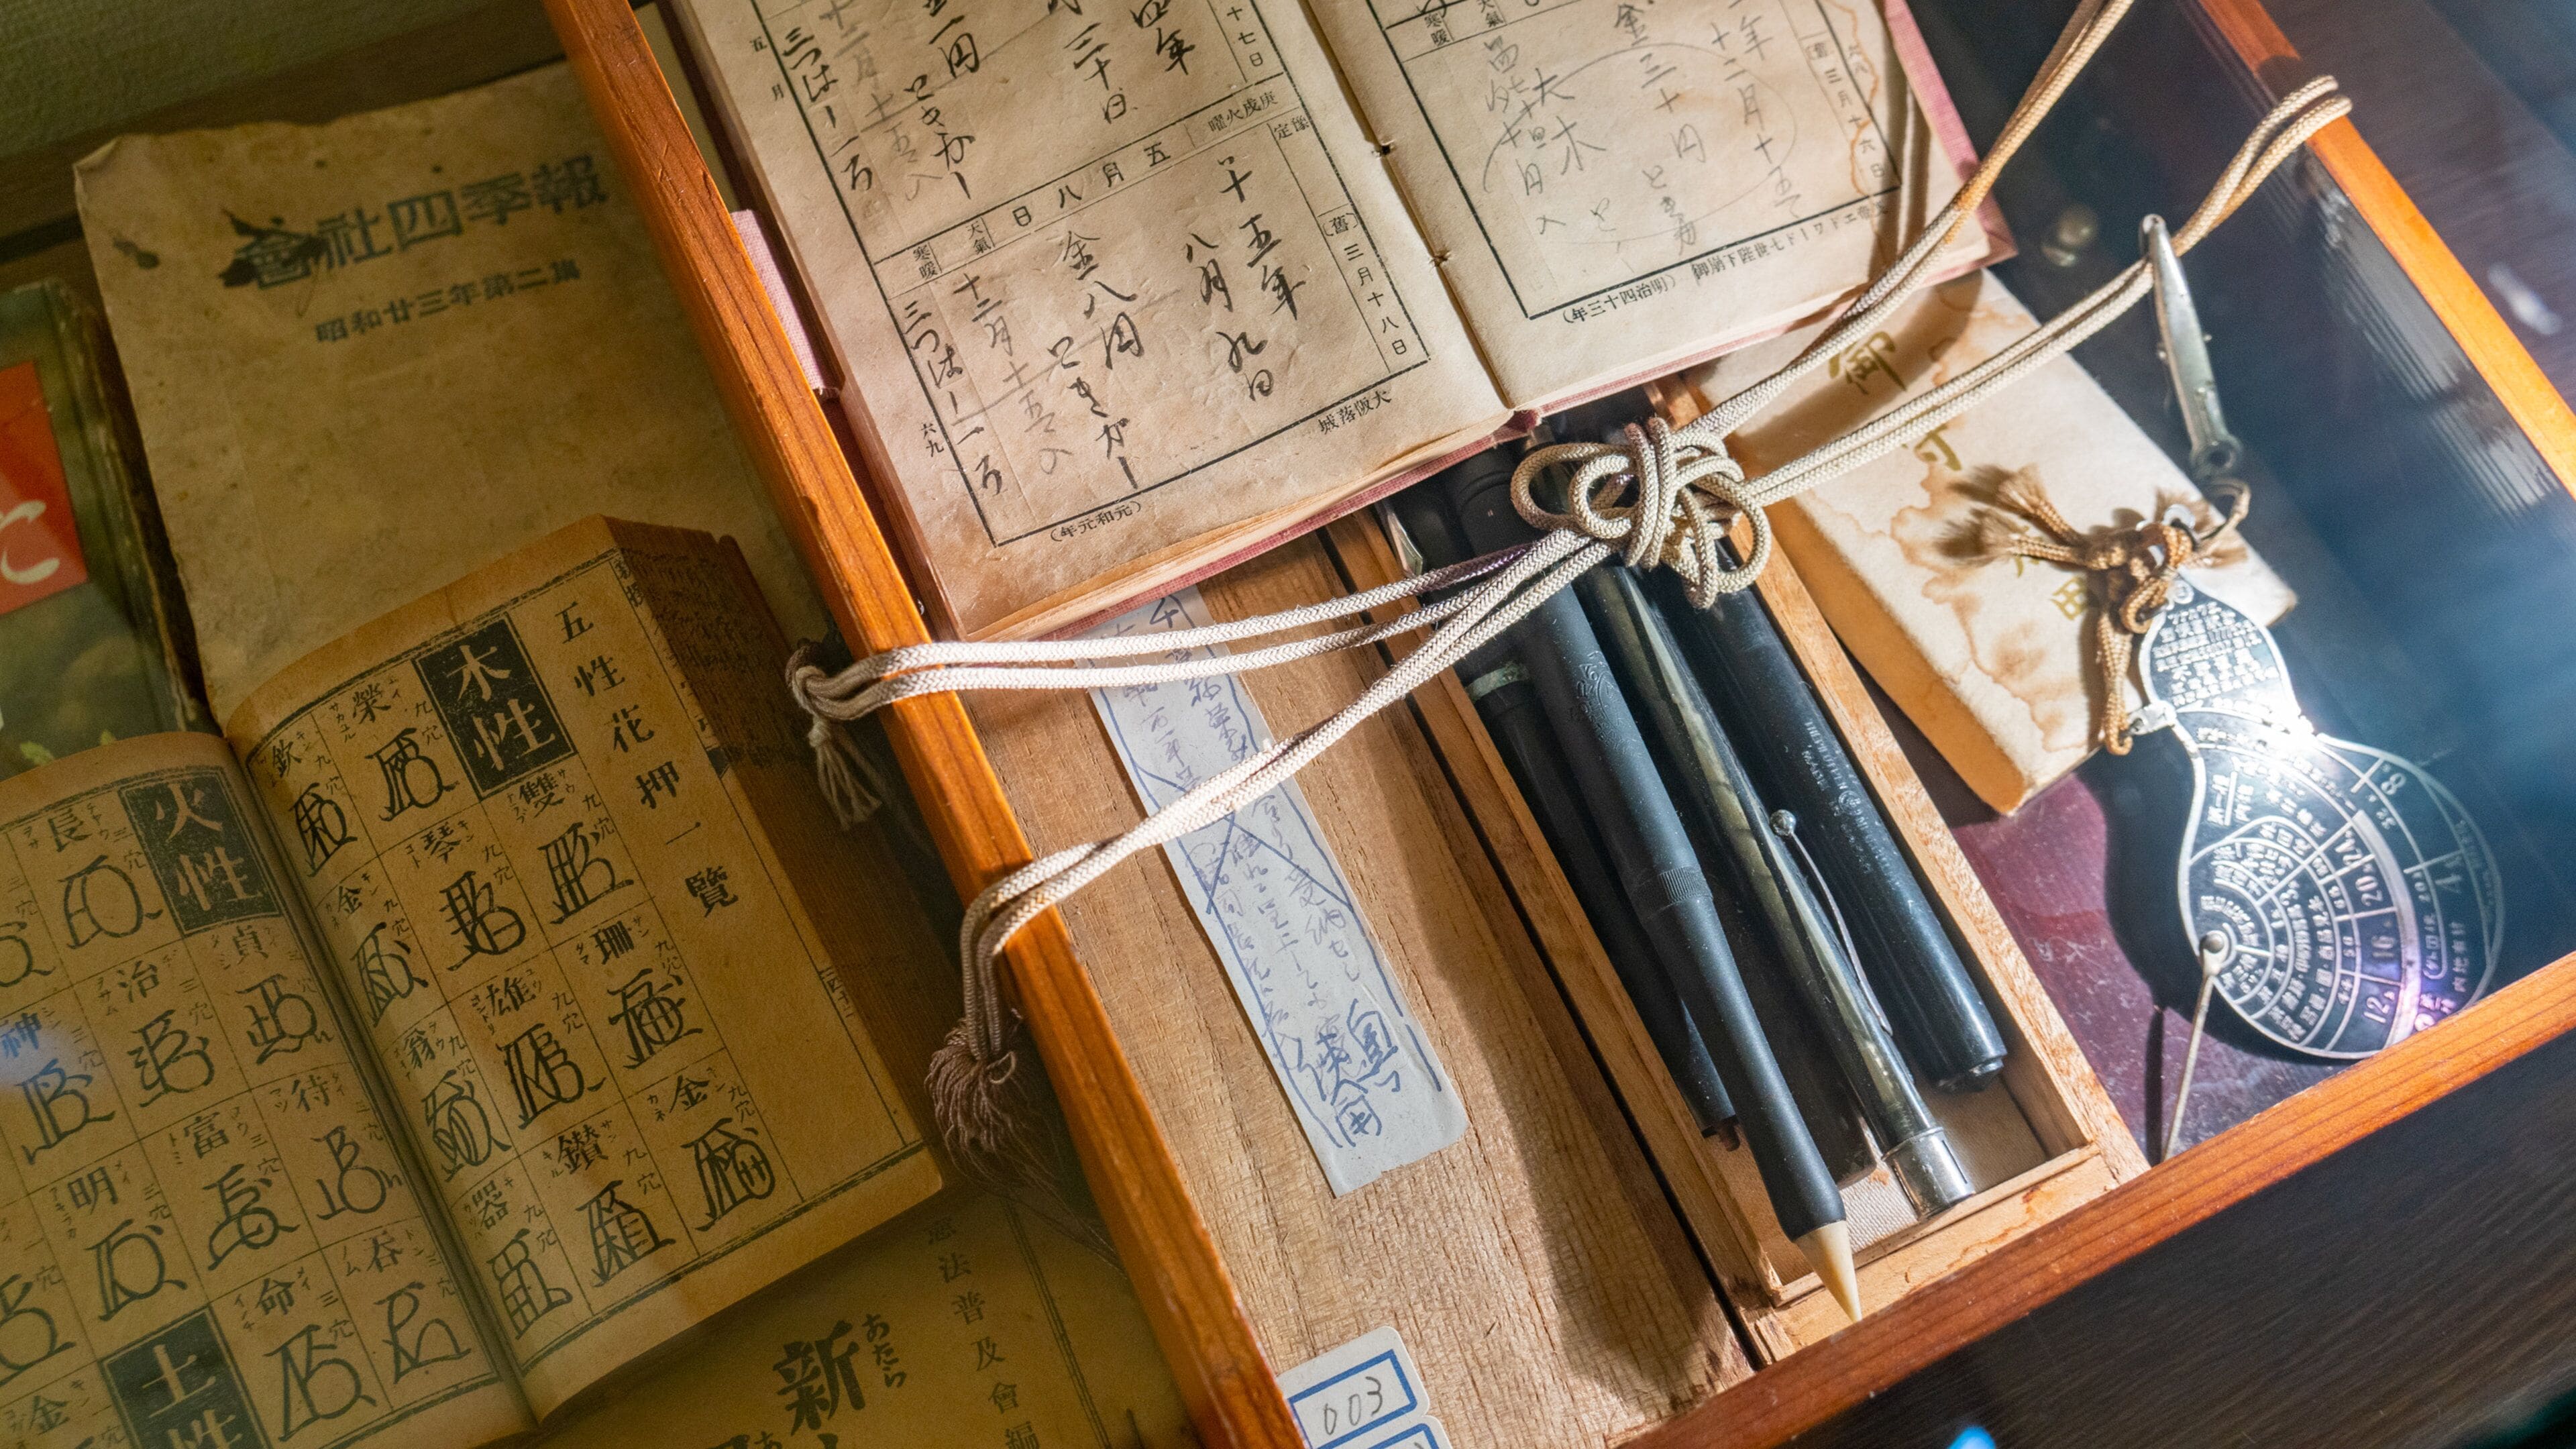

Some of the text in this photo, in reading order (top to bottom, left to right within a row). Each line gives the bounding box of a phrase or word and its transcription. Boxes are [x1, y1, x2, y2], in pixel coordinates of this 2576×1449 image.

[750, 36, 785, 101] 五月
[967, 222, 992, 254] 天氣
[912, 244, 938, 280] 寒暖
[921, 421, 945, 458] 六九
[352, 682, 392, 725] 榮
[413, 700, 445, 746] 九穴
[445, 644, 557, 772] 木性
[315, 754, 343, 798] 九穴
[519, 771, 567, 820] 雙
[48, 805, 93, 853] 長
[582, 792, 616, 837] 九穴
[156, 782, 264, 912] 火性
[423, 824, 464, 865] 琴
[481, 843, 514, 886] 九穴
[337, 885, 364, 916] 金
[383, 898, 411, 937] 九穴
[232, 925, 269, 966] 貞
[117, 959, 160, 1004] 治
[178, 977, 214, 1026] 三穴
[485, 975, 537, 1017] 雄
[551, 991, 584, 1034] 九穴
[71, 1026, 104, 1070] 三穴
[404, 1028, 436, 1069] 翁
[449, 1034, 477, 1076] 九穴
[291, 1075, 331, 1114] 待
[669, 1073, 712, 1112] 金
[727, 1082, 759, 1124] 九穴
[182, 1111, 230, 1160] 富
[249, 1133, 282, 1177] 三穴
[67, 1166, 119, 1215] 明
[623, 1148, 663, 1193] 九穴
[142, 1182, 172, 1222] 三穴
[471, 1178, 511, 1232] 器
[523, 1203, 561, 1253] 九穴
[256, 1277, 296, 1316] 命
[317, 1290, 356, 1340] 三穴
[861, 1312, 908, 1389] あたら
[772, 1318, 868, 1437] 新
[30, 1394, 71, 1438] 金
[1324, 1376, 1383, 1436] 003
